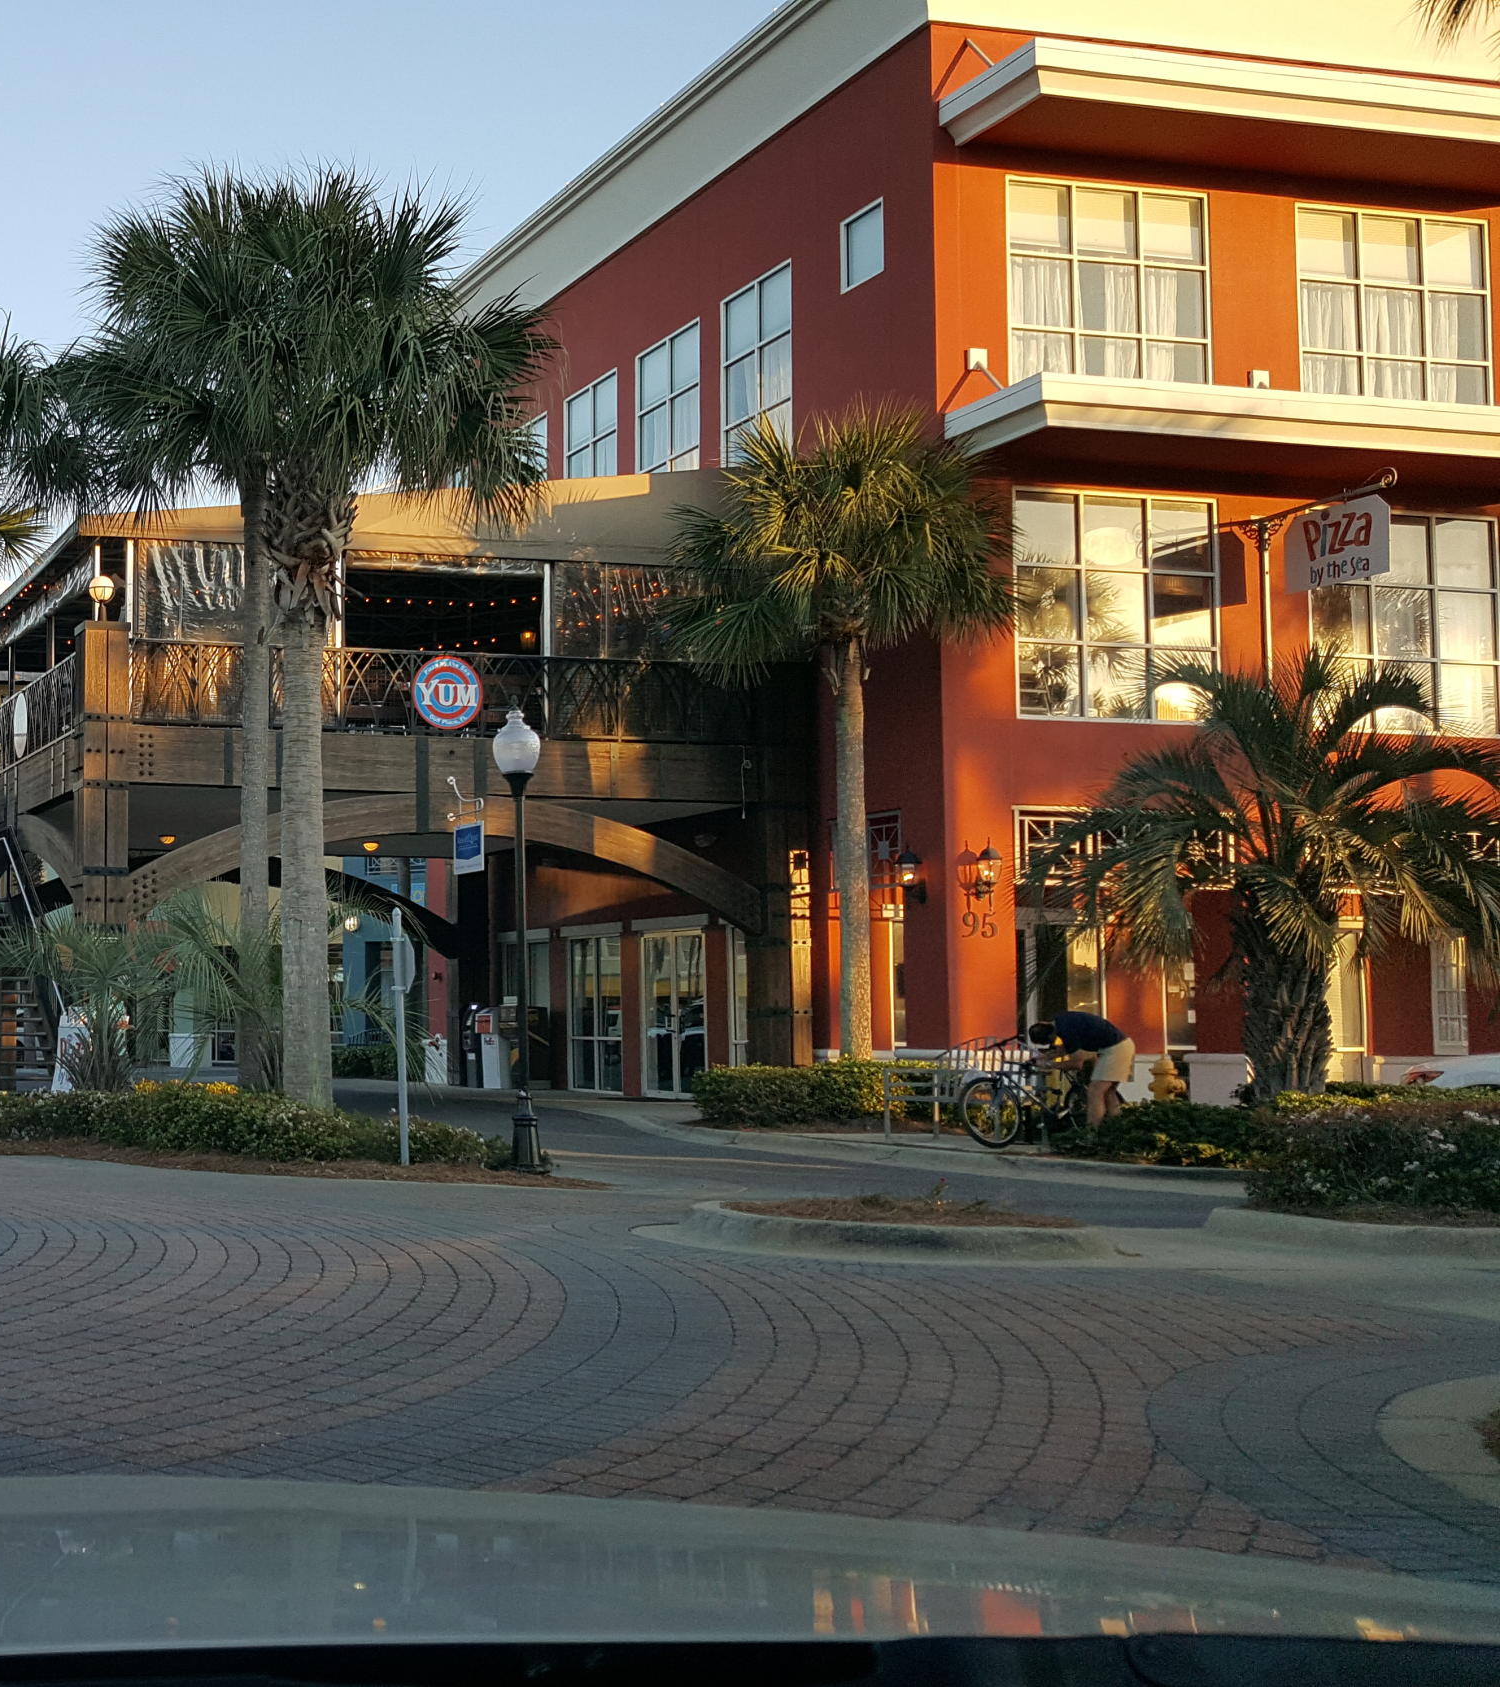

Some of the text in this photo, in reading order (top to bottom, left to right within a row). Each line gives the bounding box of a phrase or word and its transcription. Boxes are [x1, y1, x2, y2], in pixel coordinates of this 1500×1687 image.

[1303, 510, 1372, 561] Pizza
[1309, 566, 1323, 587] by
[1327, 560, 1348, 579] the
[416, 679, 478, 707] YUM
[962, 911, 998, 938] 95
